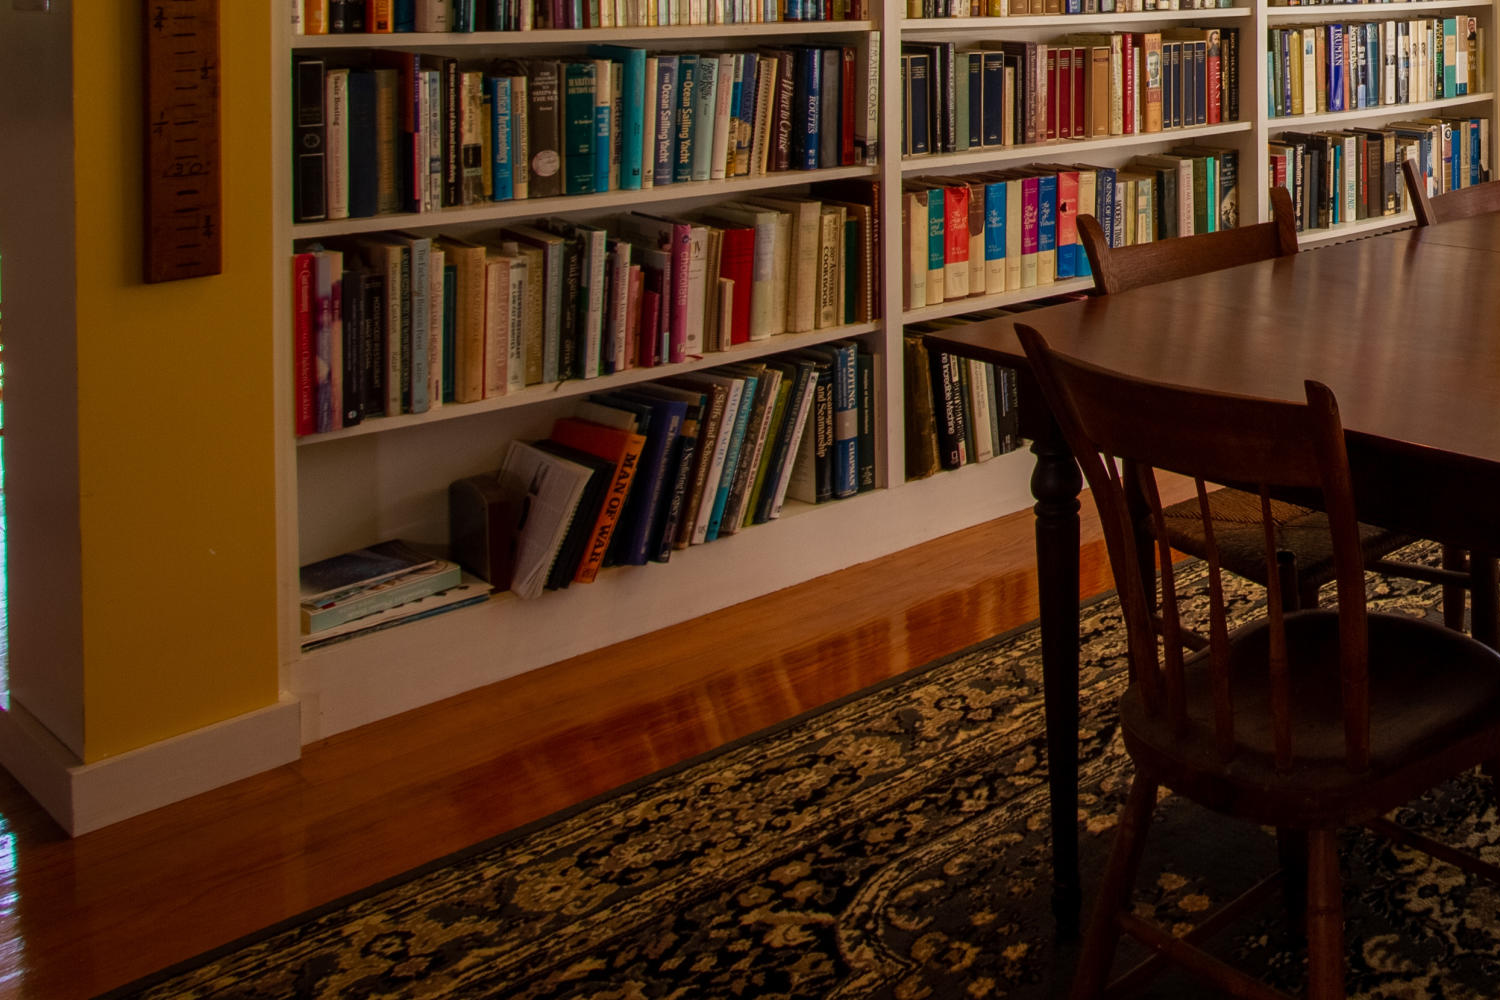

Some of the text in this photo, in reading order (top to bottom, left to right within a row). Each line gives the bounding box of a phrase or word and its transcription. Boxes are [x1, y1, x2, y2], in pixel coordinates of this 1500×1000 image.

[1335, 28, 1343, 66] TRUMAN
[333, 76, 341, 127] Basic Boating
[448, 88, 456, 112] science
[661, 83, 671, 109] Ocean
[682, 81, 694, 107] Ocean
[869, 49, 878, 122] MAINE COAST
[497, 81, 510, 163] Nautical Archaeology
[658, 110, 670, 139] Sailing
[679, 108, 693, 138] Sailing
[779, 79, 794, 152] Where to Cruise
[808, 95, 816, 134] ROUTES
[659, 140, 670, 163] Yacht
[680, 139, 691, 163] Yacht
[415, 249, 425, 261] The
[678, 251, 689, 306] chocolate
[415, 329, 424, 350] Forest
[943, 363, 953, 400] Incredible
[816, 386, 827, 457] and Seamanship
[946, 401, 956, 434] Machine
[696, 394, 725, 486] Skiffs and Schooners
[848, 442, 856, 486] CHAPMAN
[589, 453, 636, 562] MAN OF WAR
[671, 489, 684, 516] Legacy
